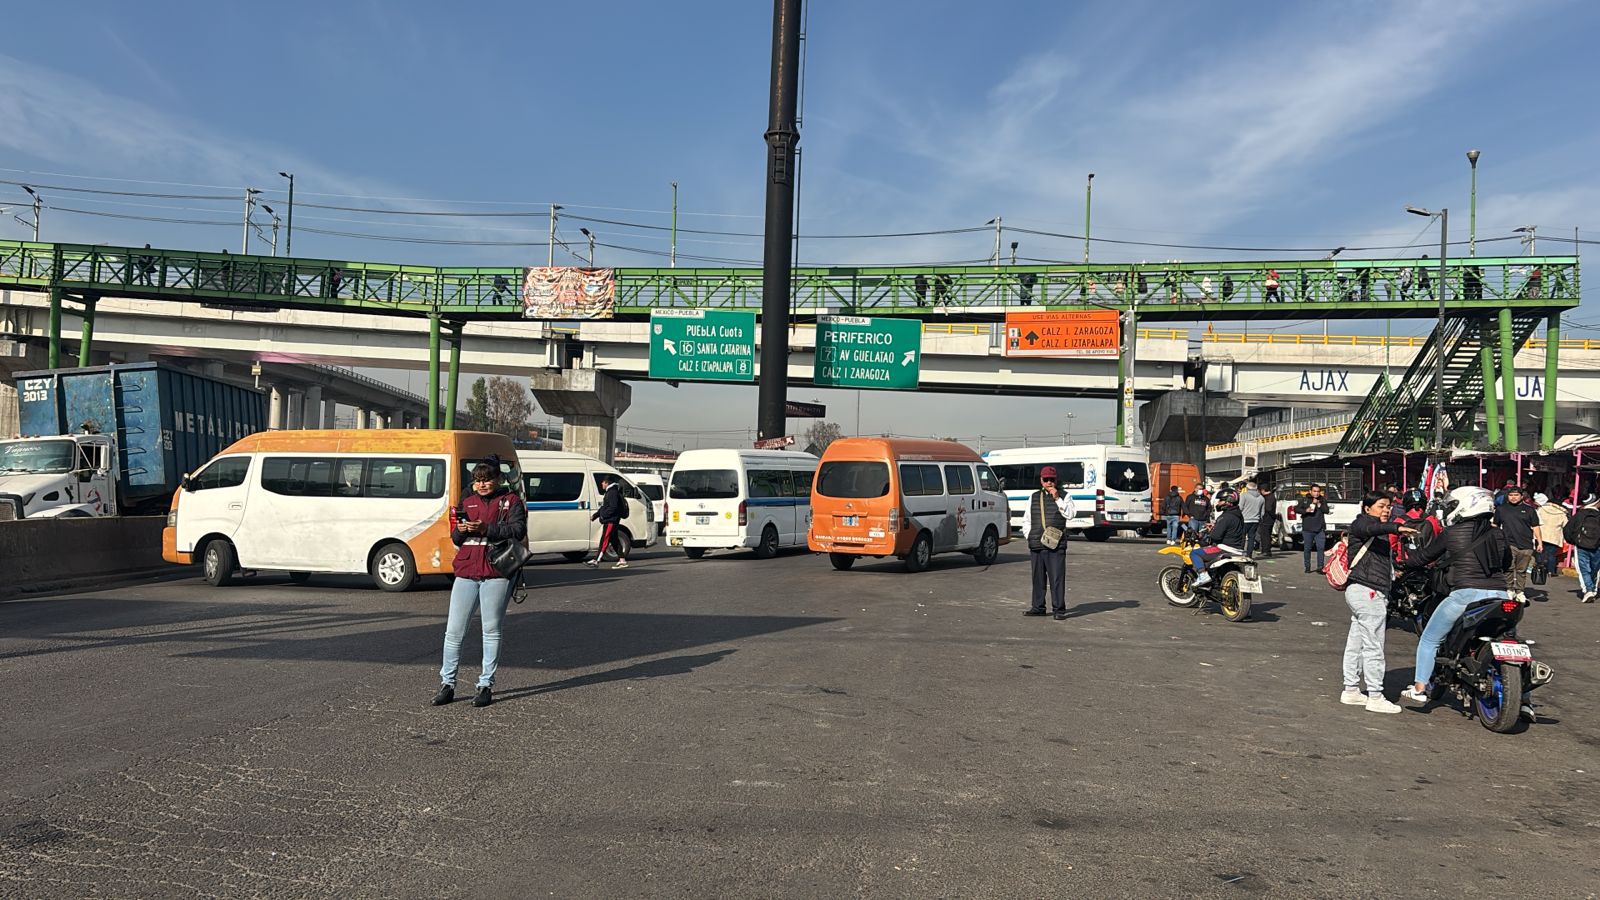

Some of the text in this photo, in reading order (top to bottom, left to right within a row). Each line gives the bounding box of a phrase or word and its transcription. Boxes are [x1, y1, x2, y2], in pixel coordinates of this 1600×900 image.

[719, 325, 743, 338] Cuota
[824, 331, 893, 345] PERIFERICO
[1073, 326, 1114, 336] ZARAGOZA
[682, 342, 751, 356] 10 SANTA CATARINA
[1064, 339, 1069, 348] E
[1071, 338, 1114, 348] IZTAPALAPA
[839, 349, 850, 361] AV
[853, 350, 894, 364] GUELATAO
[695, 360, 700, 372] E
[822, 366, 841, 379] CALZ
[850, 367, 890, 381] ZARAGOZA
[1300, 369, 1349, 391] AJAX
[25, 378, 52, 390] CZY
[1517, 375, 1542, 398] JA
